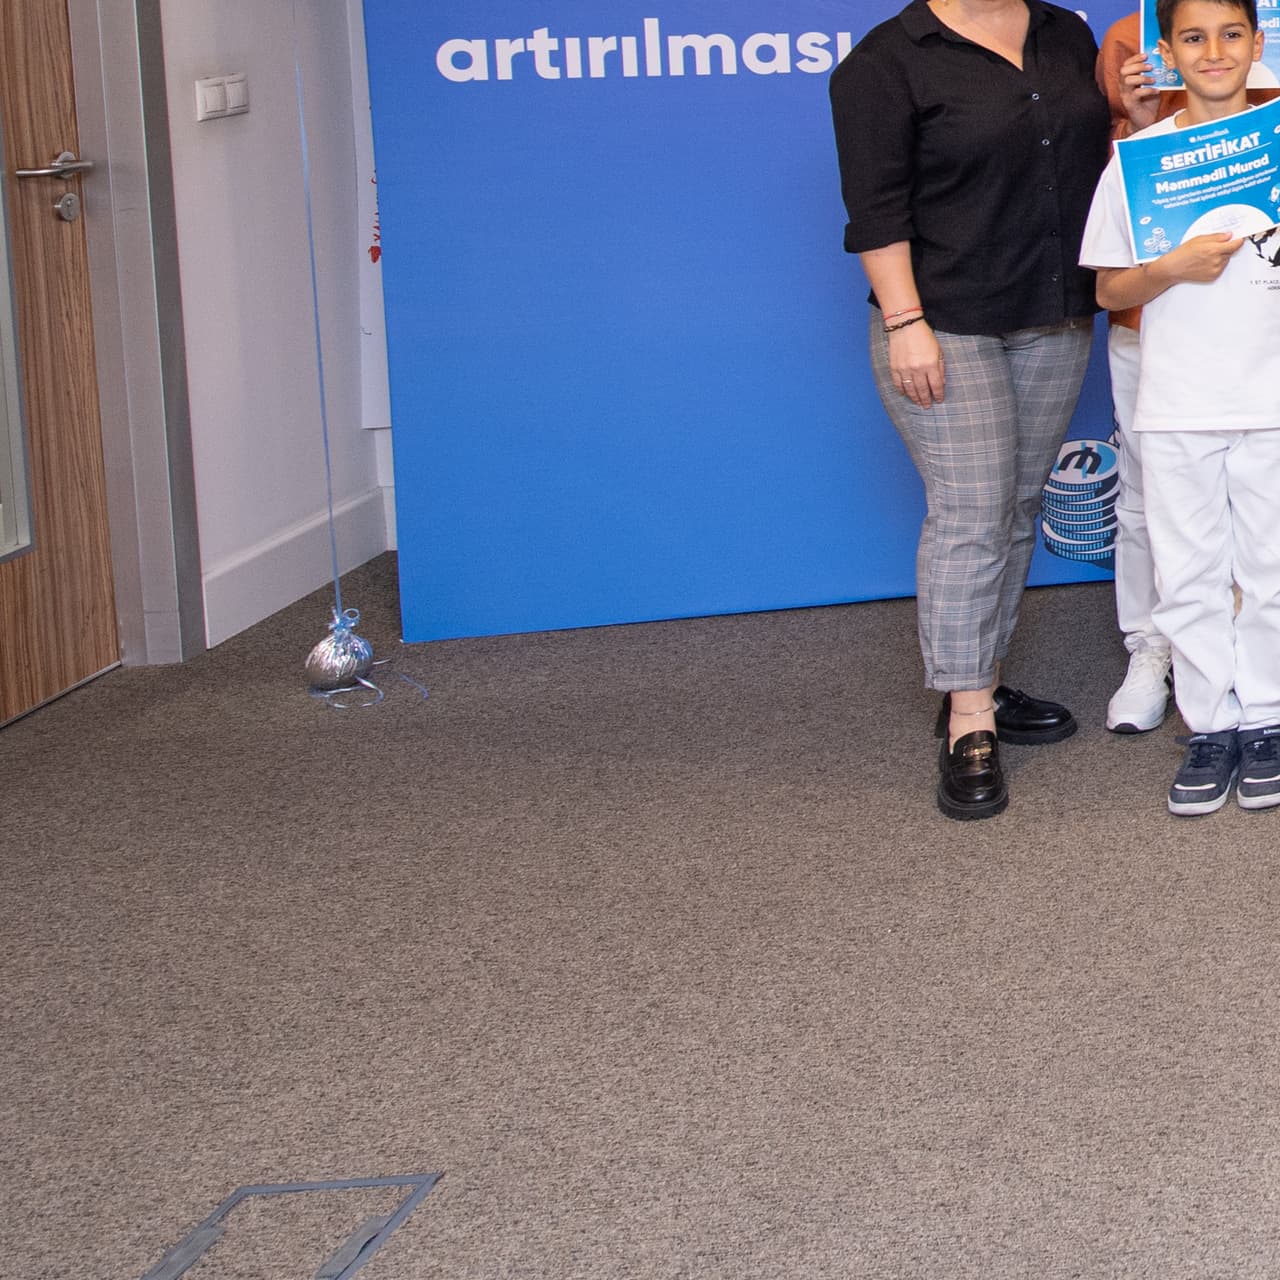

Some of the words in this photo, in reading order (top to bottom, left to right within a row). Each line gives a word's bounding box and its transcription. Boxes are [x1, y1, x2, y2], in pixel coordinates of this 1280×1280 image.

[436, 18, 851, 82] artırılması
[1160, 132, 1261, 170] SERTİFİKAT
[1155, 165, 1228, 194] Məmmədli
[1229, 153, 1270, 178] Murad
